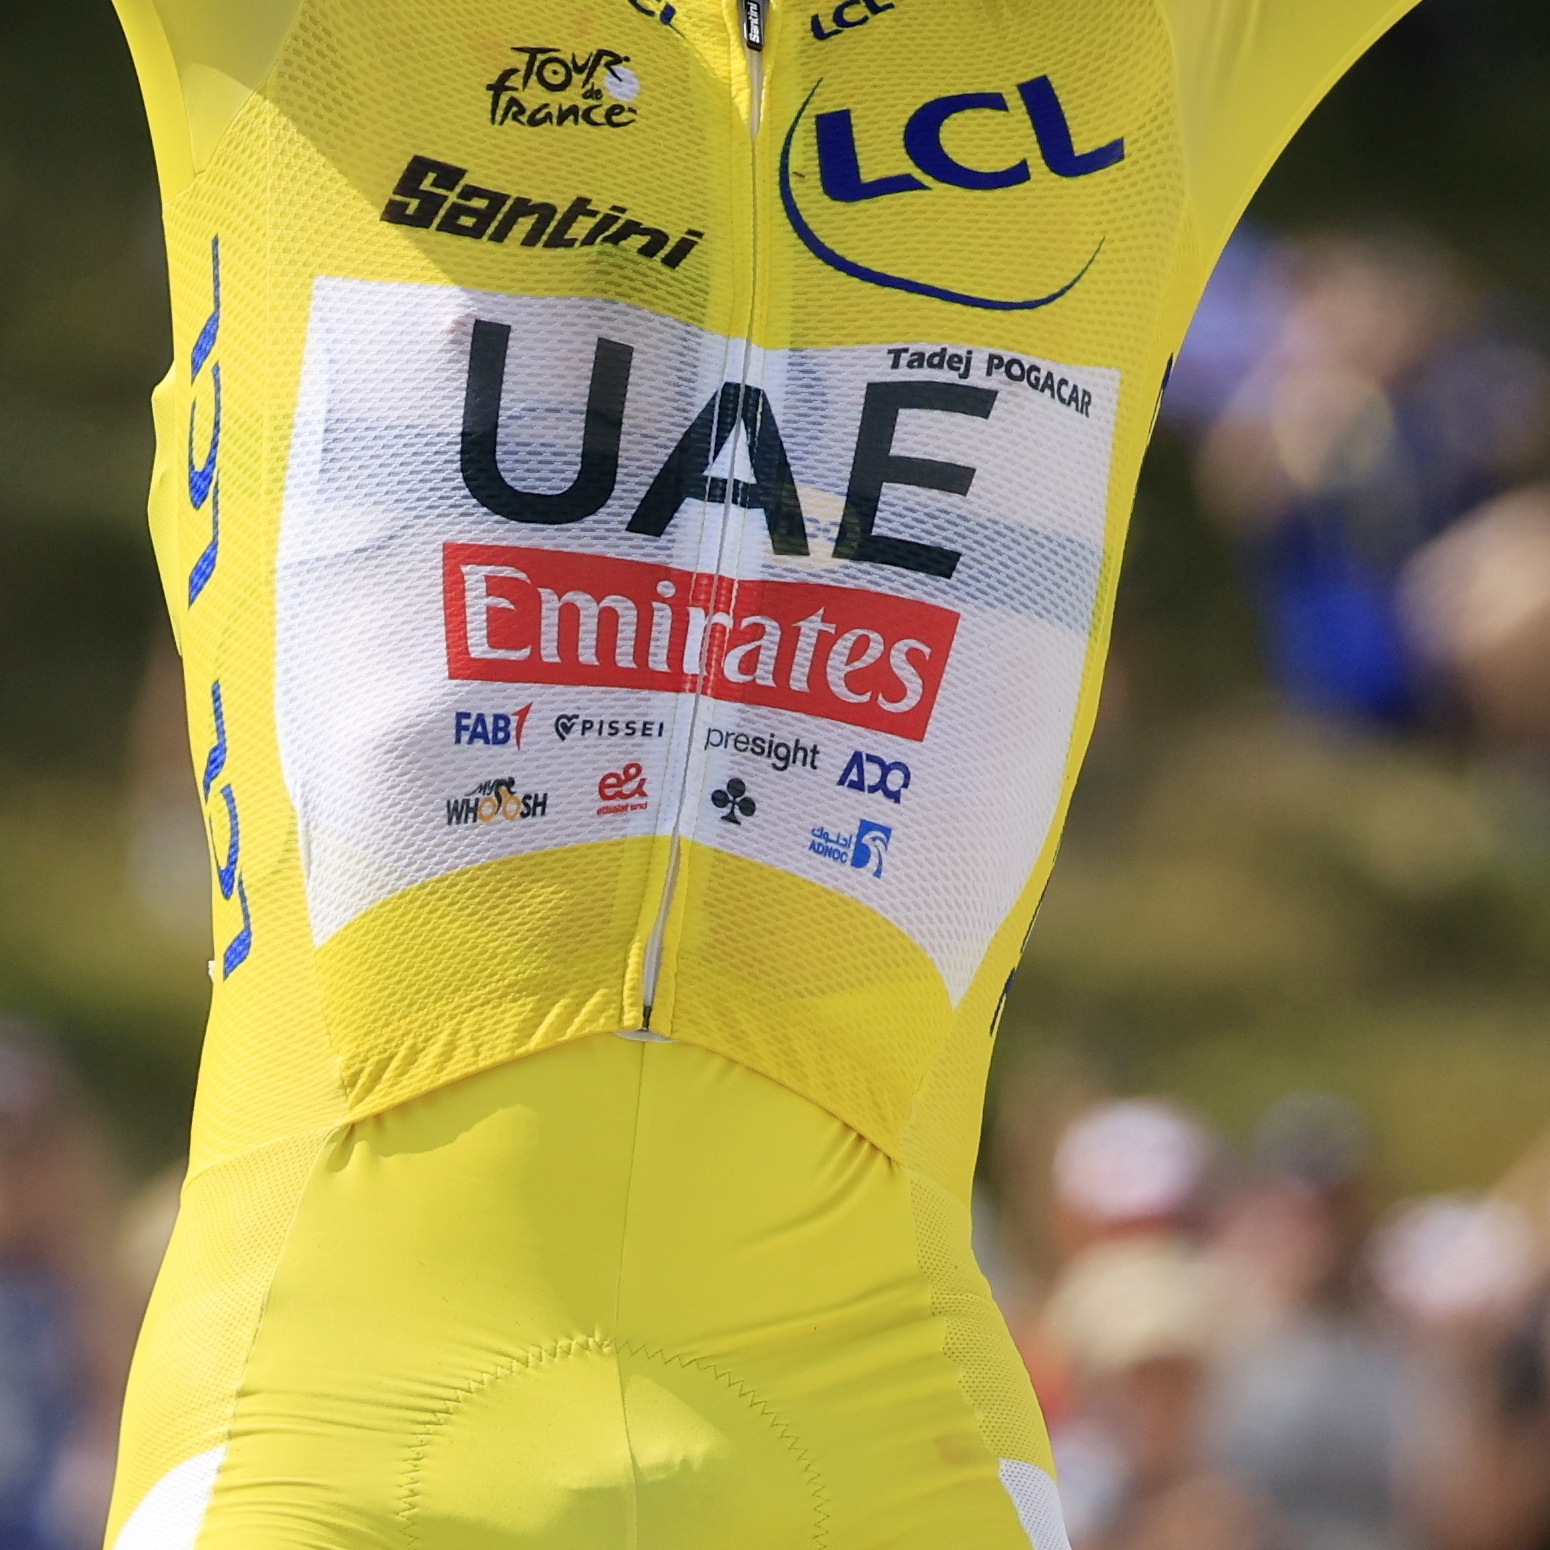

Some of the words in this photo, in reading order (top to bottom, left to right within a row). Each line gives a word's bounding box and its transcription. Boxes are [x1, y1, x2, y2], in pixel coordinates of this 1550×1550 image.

[748, 2, 760, 44] Santini
[582, 82, 604, 100] de
[815, 75, 1125, 203] LCL
[379, 154, 704, 270] Santini
[887, 347, 974, 380] Tadej
[986, 353, 1093, 418] POGACAR
[188, 234, 222, 610] LCL
[459, 319, 999, 578] UAE
[461, 563, 934, 716] Emirates
[581, 719, 665, 738] PISSEI
[704, 728, 821, 771] presight
[836, 750, 911, 804] ADQ
[808, 839, 849, 864] ADNOC
